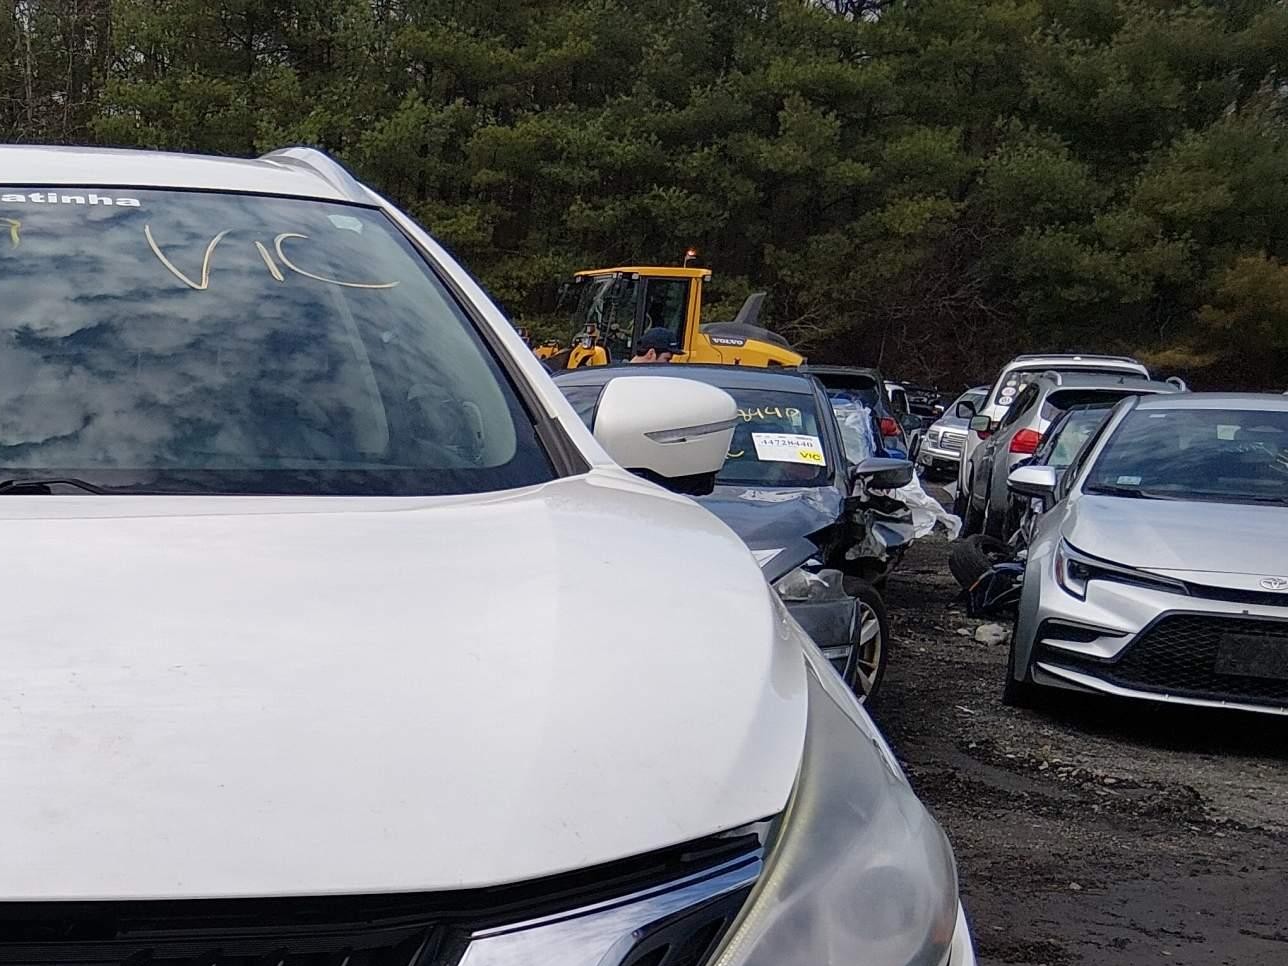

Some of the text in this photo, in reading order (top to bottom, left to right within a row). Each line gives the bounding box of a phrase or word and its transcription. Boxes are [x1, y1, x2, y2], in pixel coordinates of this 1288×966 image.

[144, 224, 401, 290] VIC
[712, 338, 743, 346] VOLVO
[799, 450, 821, 461] VIC
